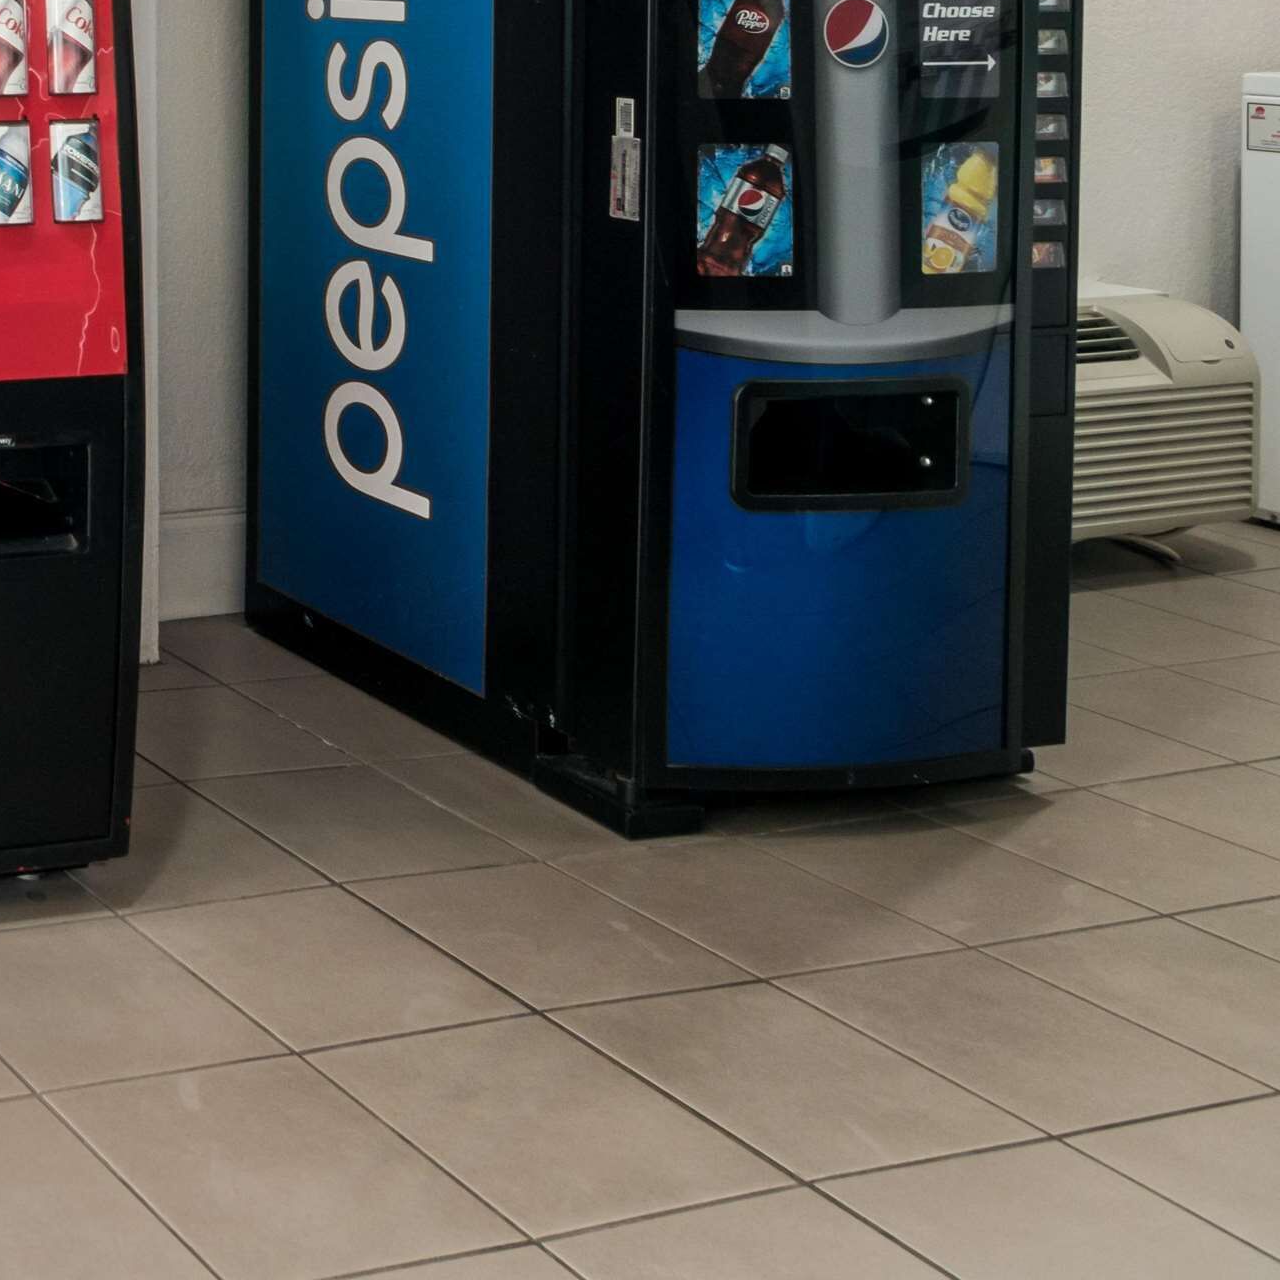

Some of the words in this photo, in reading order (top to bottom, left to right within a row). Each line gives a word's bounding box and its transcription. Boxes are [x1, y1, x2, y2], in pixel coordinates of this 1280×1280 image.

[748, 11, 762, 21] Dr
[922, 3, 995, 18] Choose
[737, 10, 767, 29] Pepper
[923, 26, 971, 42] Here
